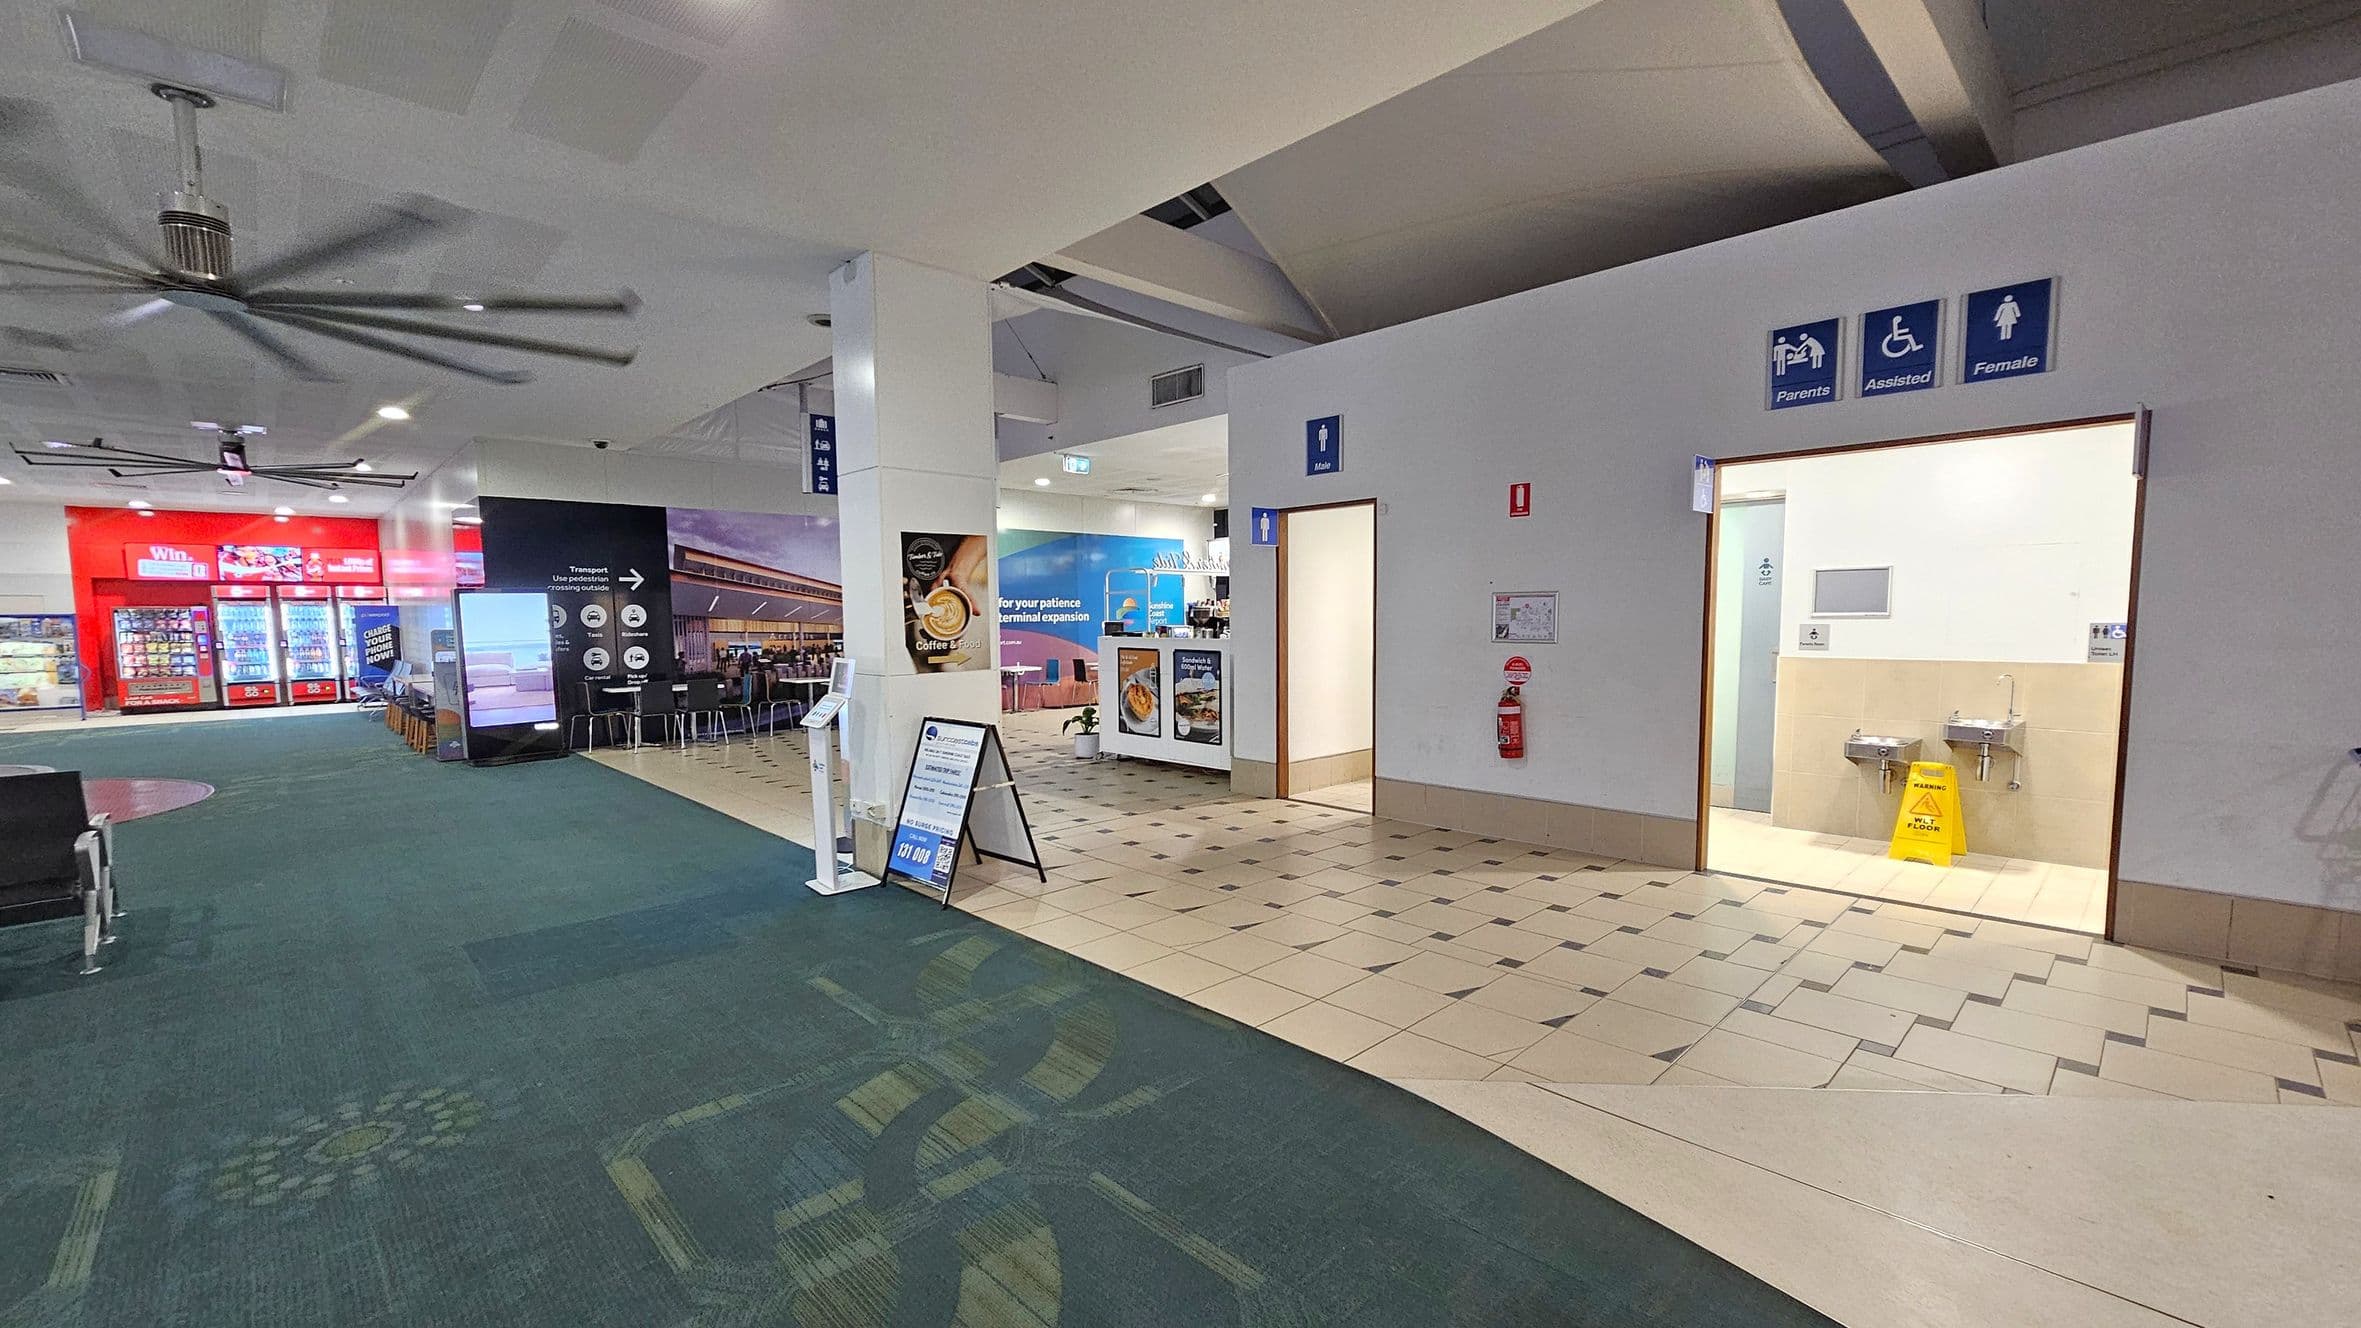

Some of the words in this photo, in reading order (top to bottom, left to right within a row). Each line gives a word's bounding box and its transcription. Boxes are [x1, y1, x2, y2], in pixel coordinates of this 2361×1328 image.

[1972, 355, 2039, 375] Female
[1864, 371, 1932, 391] Assisted
[1776, 385, 1831, 402] Parents
[1314, 461, 1331, 471] Male
[569, 565, 608, 575] Transport
[568, 575, 609, 583] pedestrian
[547, 584, 580, 592] crossing
[581, 584, 609, 592] outside
[1014, 599, 1040, 610] your
[1040, 597, 1081, 610] patience
[999, 611, 1040, 623] terminal
[1041, 611, 1090, 624] expansion
[363, 624, 392, 639] CHARGE
[365, 633, 392, 647] YOUR
[916, 640, 948, 651] Coffee
[949, 640, 957, 650] &
[959, 640, 982, 649] Food
[365, 641, 393, 656] PHONE
[366, 649, 394, 664] NOW!
[1197, 663, 1212, 671] Water
[1913, 783, 1948, 791] WARNING
[1907, 823, 1941, 832] FLOOR
[897, 842, 914, 859] 131
[912, 846, 932, 865] 008
